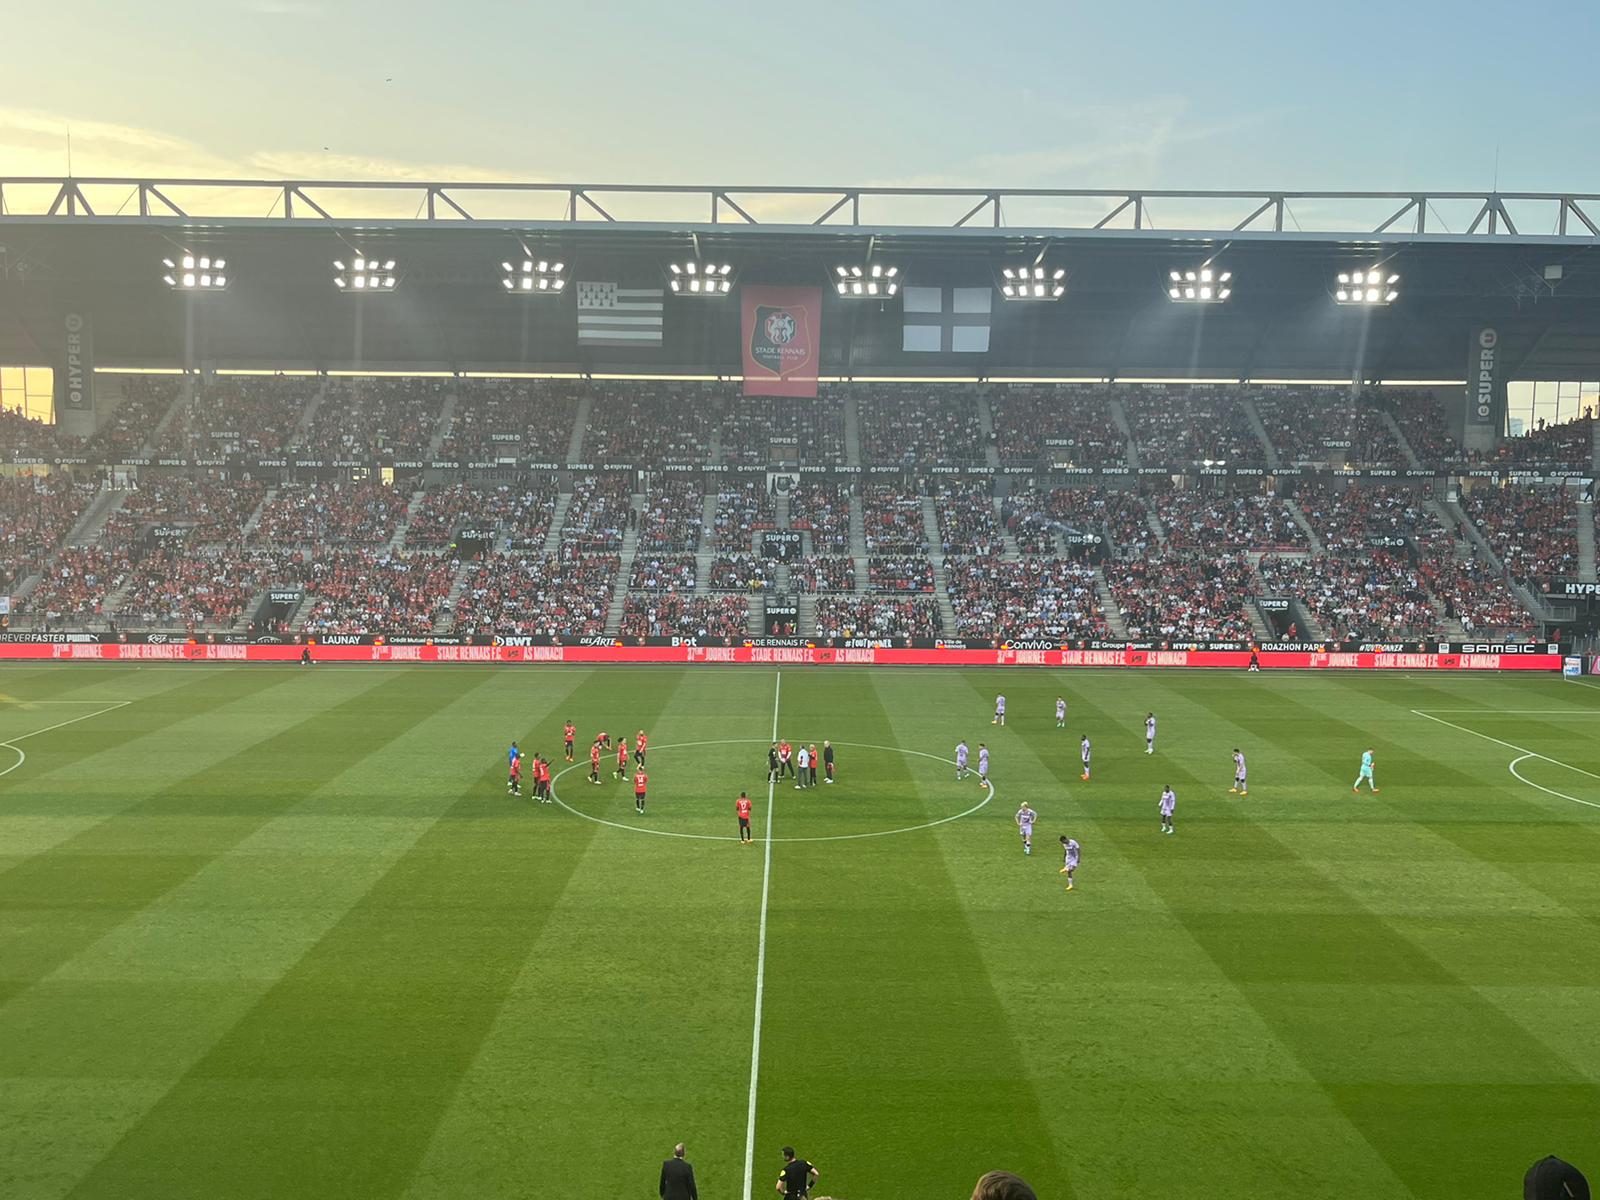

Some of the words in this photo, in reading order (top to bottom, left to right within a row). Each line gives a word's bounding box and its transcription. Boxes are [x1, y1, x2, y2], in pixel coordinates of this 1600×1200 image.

[67, 333, 82, 389] HYPER
[1478, 349, 1495, 404] SUPER
[1565, 584, 1600, 594] HYPE
[322, 636, 361, 644] LAUNAY
[505, 637, 532, 646] BWT
[671, 637, 697, 646] Blot
[1261, 643, 1302, 651] ROAZHON
[119, 643, 142, 658] STADE
[143, 643, 174, 658] RENNAIS
[206, 643, 216, 658] AS
[217, 643, 247, 658] MONACO
[438, 646, 459, 660] STADE
[460, 646, 490, 660] RENNAIS
[523, 646, 533, 660] AS
[534, 646, 563, 660] MONACO
[752, 648, 772, 662] STADE
[773, 648, 802, 662] RENNAIS
[835, 648, 844, 662] AS
[845, 648, 875, 662] MONACO
[1462, 644, 1535, 653] SAMSIC
[1061, 650, 1083, 664] STADE
[1084, 650, 1114, 664] RENNAIS
[1146, 650, 1156, 664] AS
[1157, 650, 1187, 664] MONACO
[1374, 653, 1395, 668] STADE
[1396, 653, 1427, 668] RENNAIS
[1459, 653, 1469, 668] AS
[1470, 653, 1500, 668] MONACO
